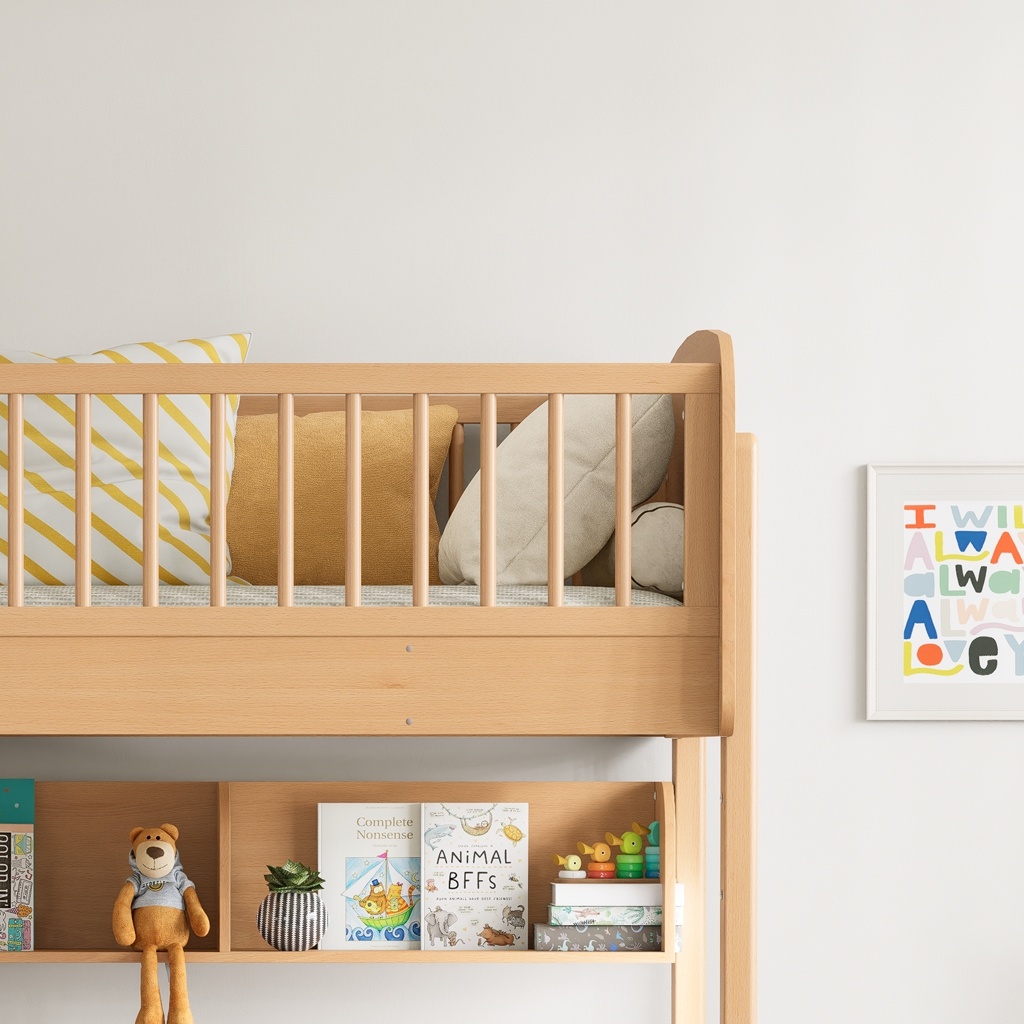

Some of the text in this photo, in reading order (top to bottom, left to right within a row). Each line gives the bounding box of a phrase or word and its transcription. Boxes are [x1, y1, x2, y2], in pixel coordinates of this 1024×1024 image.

[904, 505, 936, 529] I
[904, 531, 1024, 570] ALWA
[356, 816, 414, 834] Complete
[356, 829, 414, 840] Nonsense
[447, 871, 497, 890] BFFs
